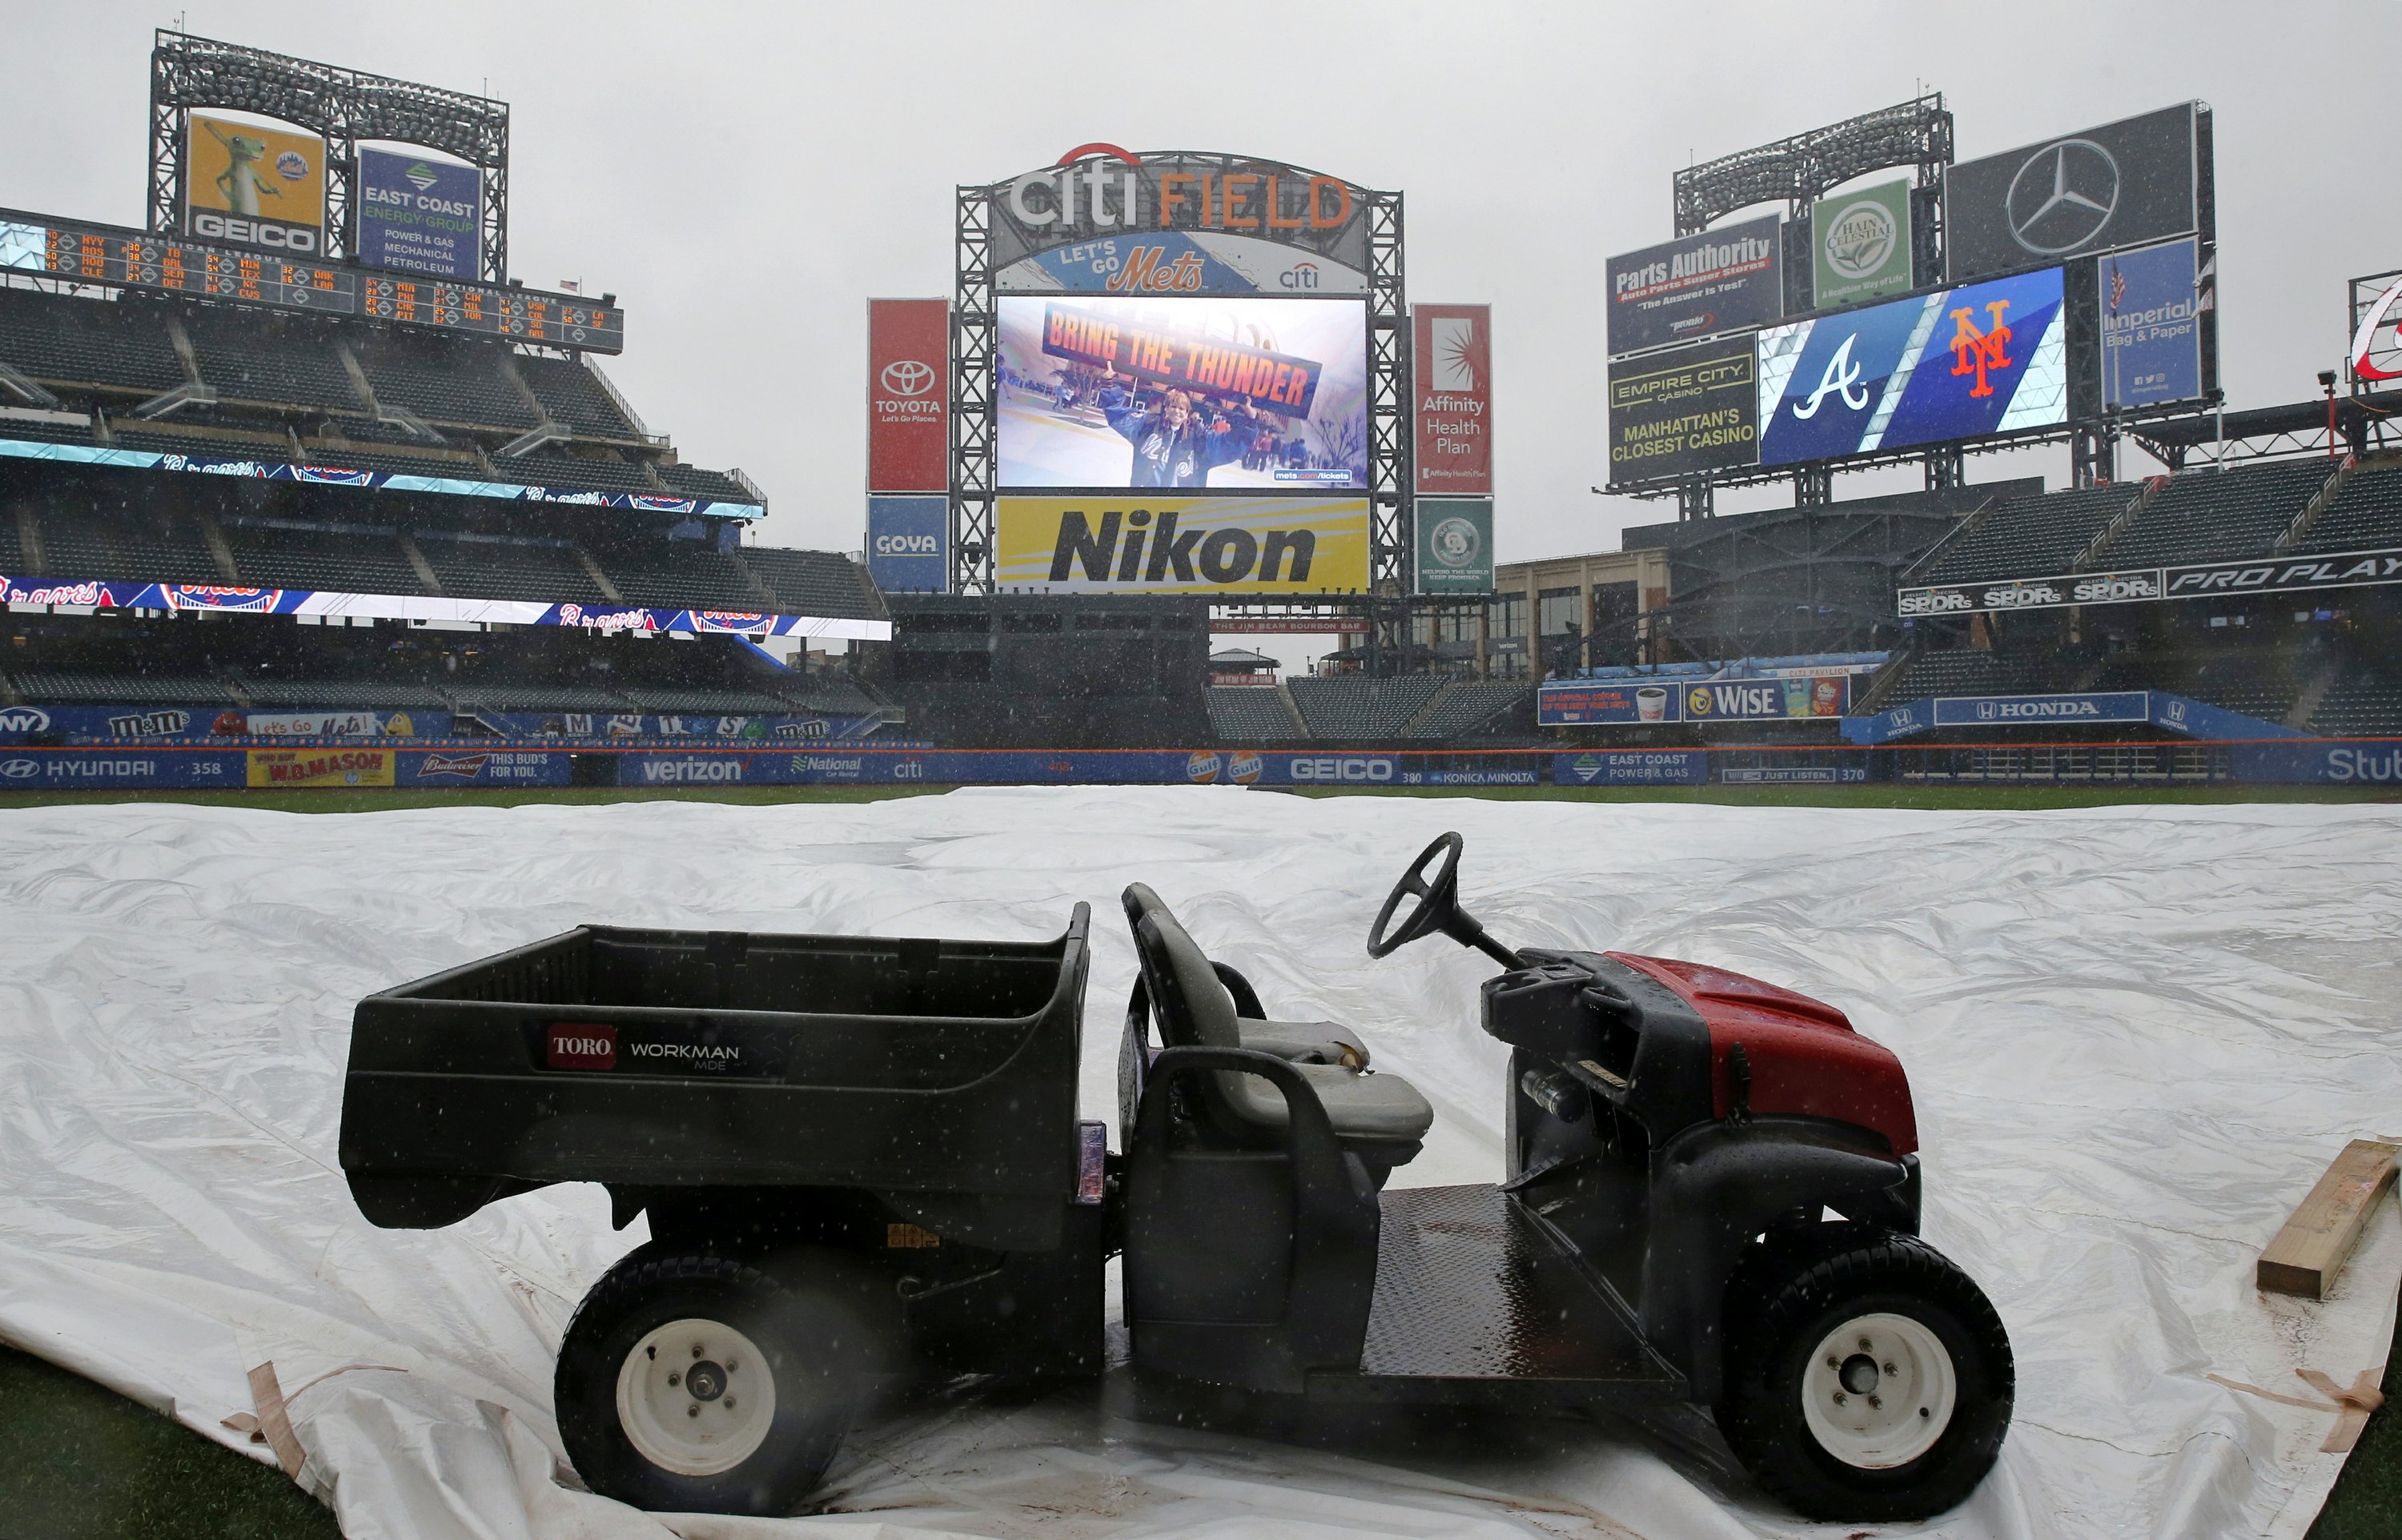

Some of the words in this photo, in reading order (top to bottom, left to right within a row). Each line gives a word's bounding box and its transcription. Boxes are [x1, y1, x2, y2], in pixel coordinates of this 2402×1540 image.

[366, 186, 412, 207] EAST
[416, 195, 475, 219] COAST
[1010, 160, 1137, 227] citi
[1160, 173, 1352, 229] FIELD
[364, 206, 422, 225] ENERGY
[425, 215, 474, 233] GROUP
[1843, 218, 1877, 235] HAIN
[82, 235, 104, 246] NYY
[195, 214, 315, 251] GEICO
[384, 229, 422, 243] POWER
[424, 235, 432, 244] &
[433, 237, 455, 247] GAS
[1827, 223, 1894, 250] CELESTIAL
[82, 247, 104, 257] BOS
[135, 236, 215, 254] AMERICAN
[226, 250, 282, 263] LEAGUE
[167, 247, 180, 258] TB
[384, 243, 455, 261] MECHANICAL
[1059, 240, 1117, 265] LET'S
[1092, 257, 1119, 275] GO
[82, 256, 104, 267] HOU
[163, 258, 183, 268] BAL
[240, 259, 260, 270] MIN
[384, 256, 455, 275] PETROLEUM
[1105, 246, 1205, 292] Mets
[1617, 261, 1666, 294] Parts
[1671, 237, 1770, 279] Authority
[82, 267, 103, 278] CLE
[163, 268, 184, 279] SEA
[239, 269, 260, 279] TEX
[314, 271, 334, 280] OAK
[1279, 267, 1318, 289] citi
[163, 278, 184, 289] DET
[243, 279, 256, 289] KC
[314, 280, 334, 290] LAA
[397, 283, 415, 293] MIA
[1621, 290, 1647, 302] Auto
[1649, 281, 1681, 295] Parts
[1683, 272, 1721, 287] Super
[1722, 260, 1765, 277] Stores
[1822, 291, 1828, 299] A
[1828, 283, 1862, 297] Healthier
[1862, 279, 1879, 290] Way
[1880, 277, 1888, 286] of
[1889, 275, 1904, 284] Life
[239, 289, 260, 299] CWS
[397, 292, 415, 301] PHI
[436, 282, 501, 296] NATIONAL
[509, 292, 557, 304] LEAGUE
[464, 293, 481, 302] CIN
[1637, 299, 1661, 311] "The
[1663, 291, 1704, 306] Answer
[1705, 287, 1716, 296] Is
[1718, 279, 1747, 292] Yes!"
[396, 302, 415, 311] CHC
[464, 302, 480, 311] MIL
[528, 302, 546, 311] WSH
[2104, 298, 2191, 331] Imperial
[397, 311, 414, 320] PIT
[528, 311, 544, 320] COL
[592, 311, 605, 319] LA
[531, 321, 542, 329] SD
[592, 320, 603, 328] SF
[1670, 315, 1705, 332] pronto
[2107, 333, 2132, 347] Bag
[2137, 331, 2147, 342] &
[2151, 323, 2192, 339] Paper
[1950, 299, 2012, 398] NY
[1049, 311, 1119, 361] BRING
[1130, 328, 1175, 375] THE
[1187, 341, 1308, 407] THUNDER
[1618, 374, 1693, 398] EMPIRE
[1697, 364, 1744, 383] CITY
[1793, 333, 1868, 419] A
[1657, 387, 1703, 402] CASINO
[876, 400, 941, 413] TOYOTA
[1423, 395, 1484, 416] Affinity
[1428, 419, 1480, 435] Health
[1624, 408, 1740, 442] MANHATTAN'S
[1437, 438, 1471, 454] Plan
[1613, 436, 1685, 462] CLOSEST
[1689, 424, 1754, 449] CASINO
[1275, 471, 1349, 479] mets.com/tickets
[876, 535, 937, 554] GOYA
[1048, 509, 1315, 584] Nikon
[2169, 567, 2275, 591] PRO
[2276, 558, 2402, 584] PLAY
[1984, 588, 2061, 608] SPDRs
[2074, 580, 2158, 600] SPDRs
[1900, 595, 1972, 612] SPDRs
[560, 604, 644, 629] Braves
[1810, 668, 1850, 676] PAVILION
[1714, 685, 1775, 715] WISE
[2000, 701, 2099, 717] HONDA
[255, 721, 287, 735] Let's
[292, 720, 311, 733] Go
[321, 716, 369, 736] Mets!
[1886, 723, 1922, 736] HONDA
[2159, 717, 2188, 732] HONDA
[427, 755, 480, 771] Budweiser
[490, 754, 514, 765] THIS
[517, 754, 548, 765] BUD'S
[807, 757, 861, 772] National
[1609, 755, 1641, 765] EAST
[1645, 754, 1688, 765] COAST
[47, 760, 155, 776] HYUNDAI
[192, 763, 221, 774] 358
[491, 767, 510, 777] FOR
[514, 767, 537, 777] YOU.
[643, 756, 741, 782] verizon
[894, 761, 922, 779] citi
[1188, 760, 1219, 776] Gulf
[1230, 760, 1260, 776] Gulf
[1291, 759, 1392, 780] GEICO
[1609, 768, 1652, 779] POWER
[1654, 768, 1662, 778] &
[1665, 768, 1689, 778] GAS
[1842, 768, 1865, 780] 370
[1403, 772, 1421, 783] 380
[1444, 772, 1485, 784] KONICA
[1487, 772, 1534, 783] MINOLTA
[1764, 772, 1789, 781] JUST
[553, 1037, 612, 1056] TORO
[631, 1044, 739, 1059] WORKMAN
[694, 1061, 726, 1071] MDE
